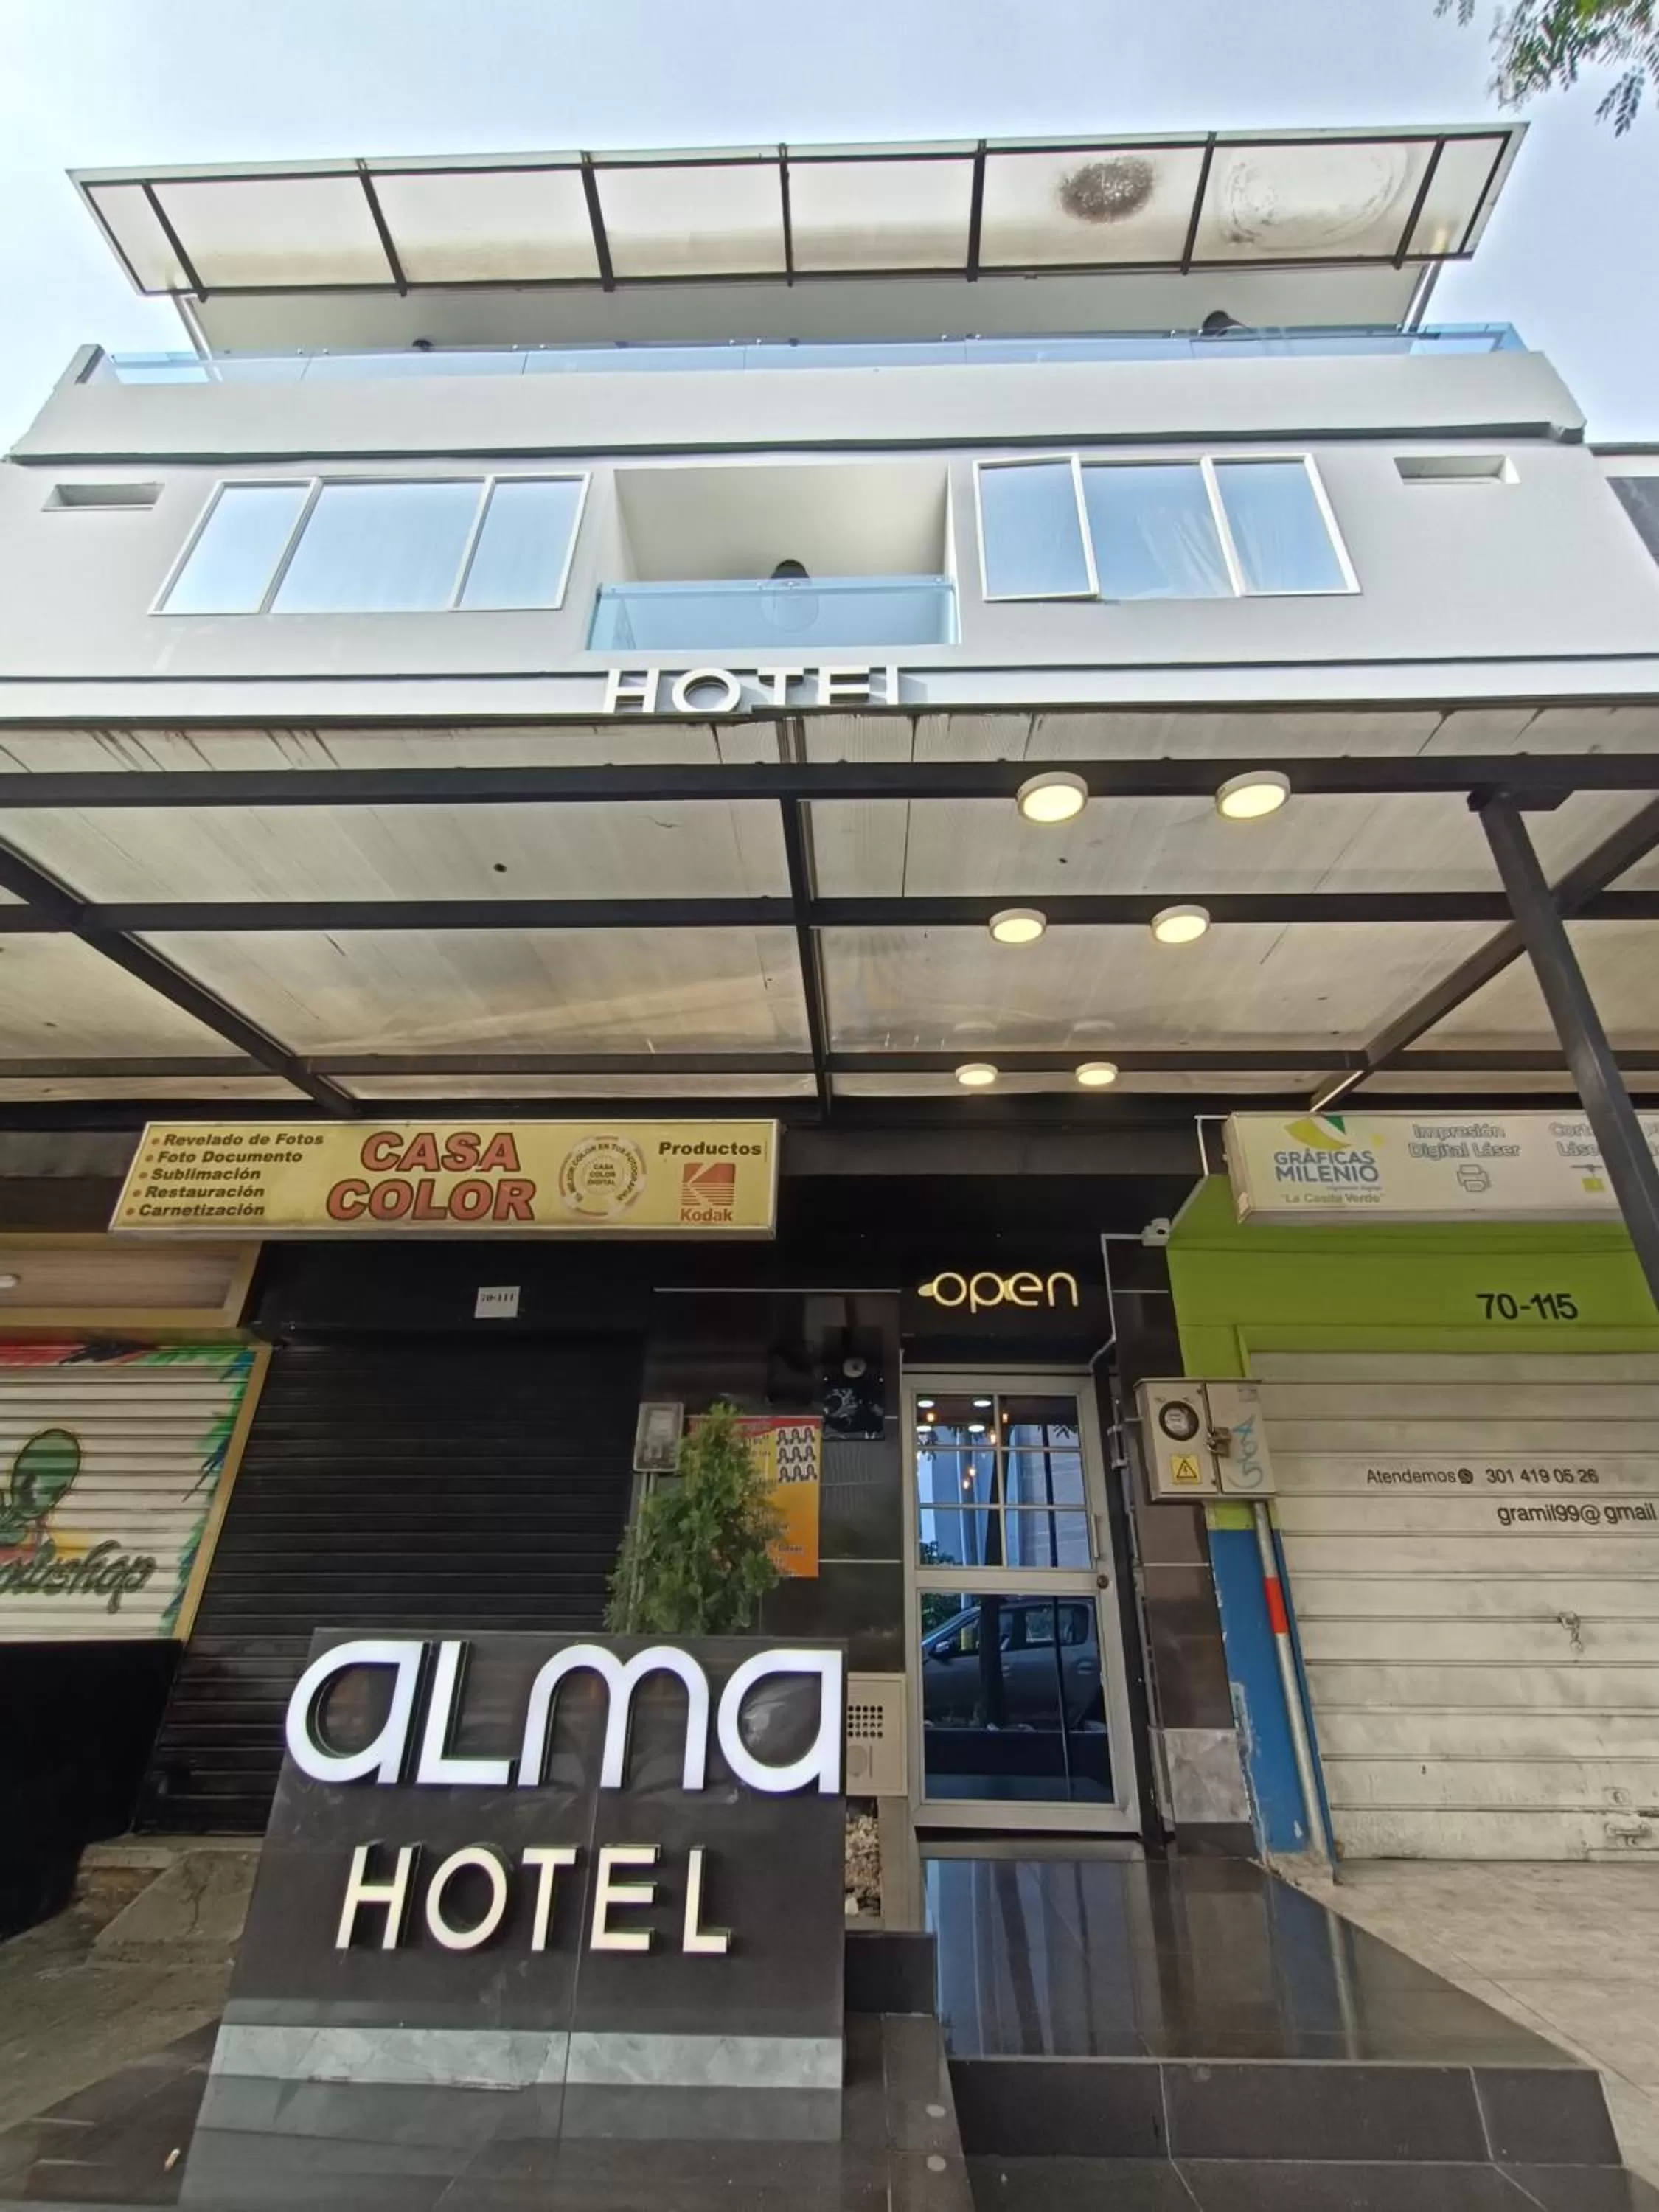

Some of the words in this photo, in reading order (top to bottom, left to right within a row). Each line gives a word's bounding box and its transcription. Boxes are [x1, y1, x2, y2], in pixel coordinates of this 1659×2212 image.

[163, 1133, 243, 1147] Revelado
[248, 1133, 271, 1147] de
[275, 1133, 324, 1146] Fotos
[1412, 1123, 1506, 1141] Impresión
[360, 1131, 521, 1172] CASA
[658, 1141, 762, 1156] Productos
[1273, 1147, 1376, 1166] GRÁFICAS
[1408, 1142, 1470, 1160] Digital
[1472, 1141, 1522, 1157] Láser
[1556, 1140, 1601, 1156] Láse
[157, 1150, 198, 1164] Foto
[201, 1150, 303, 1164] Documento
[150, 1167, 261, 1180] Sublimación
[1275, 1165, 1380, 1183] MILENIO
[144, 1185, 265, 1199] Restauración
[326, 1178, 536, 1221] COLOR
[138, 1203, 265, 1217] Carnetización
[680, 1208, 734, 1223] Kodak
[932, 1271, 1079, 1314] open
[1475, 1293, 1579, 1320] 70-115
[1366, 1468, 1458, 1484] Atendemos
[1486, 1468, 1514, 1484] 301
[1520, 1468, 1550, 1484] 419
[1553, 1467, 1575, 1484] 05
[1579, 1468, 1599, 1484] 26
[334, 1841, 733, 1954] HOTEL
